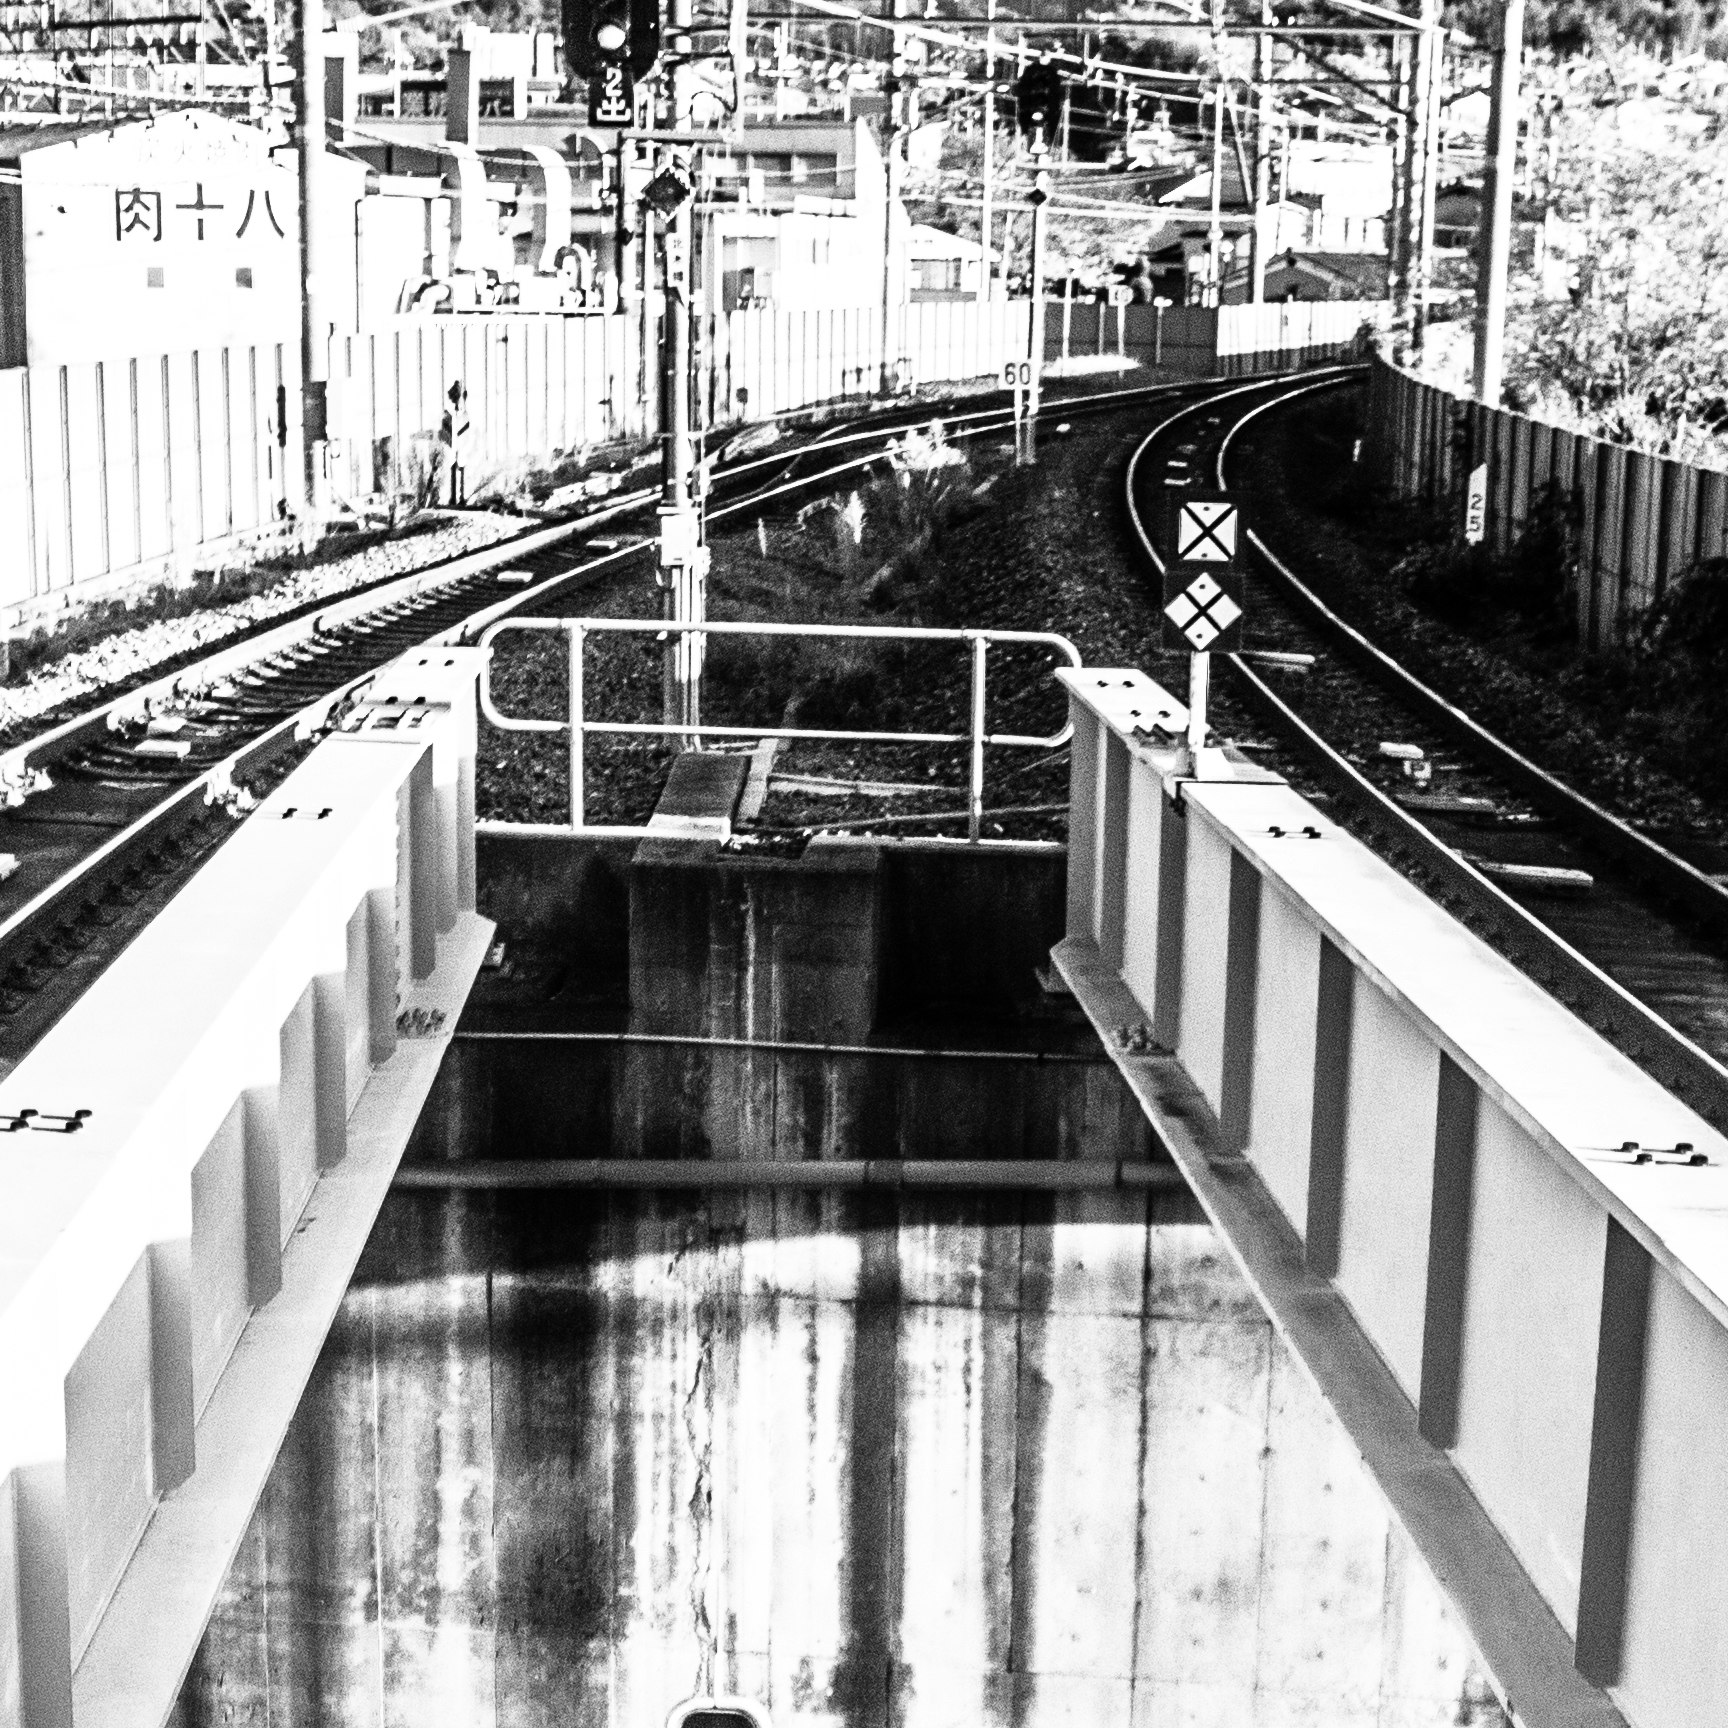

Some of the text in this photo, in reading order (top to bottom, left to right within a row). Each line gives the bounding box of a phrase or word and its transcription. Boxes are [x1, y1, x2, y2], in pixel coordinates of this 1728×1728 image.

[115, 182, 284, 242] 肉十八
[1004, 362, 1031, 386] 60
